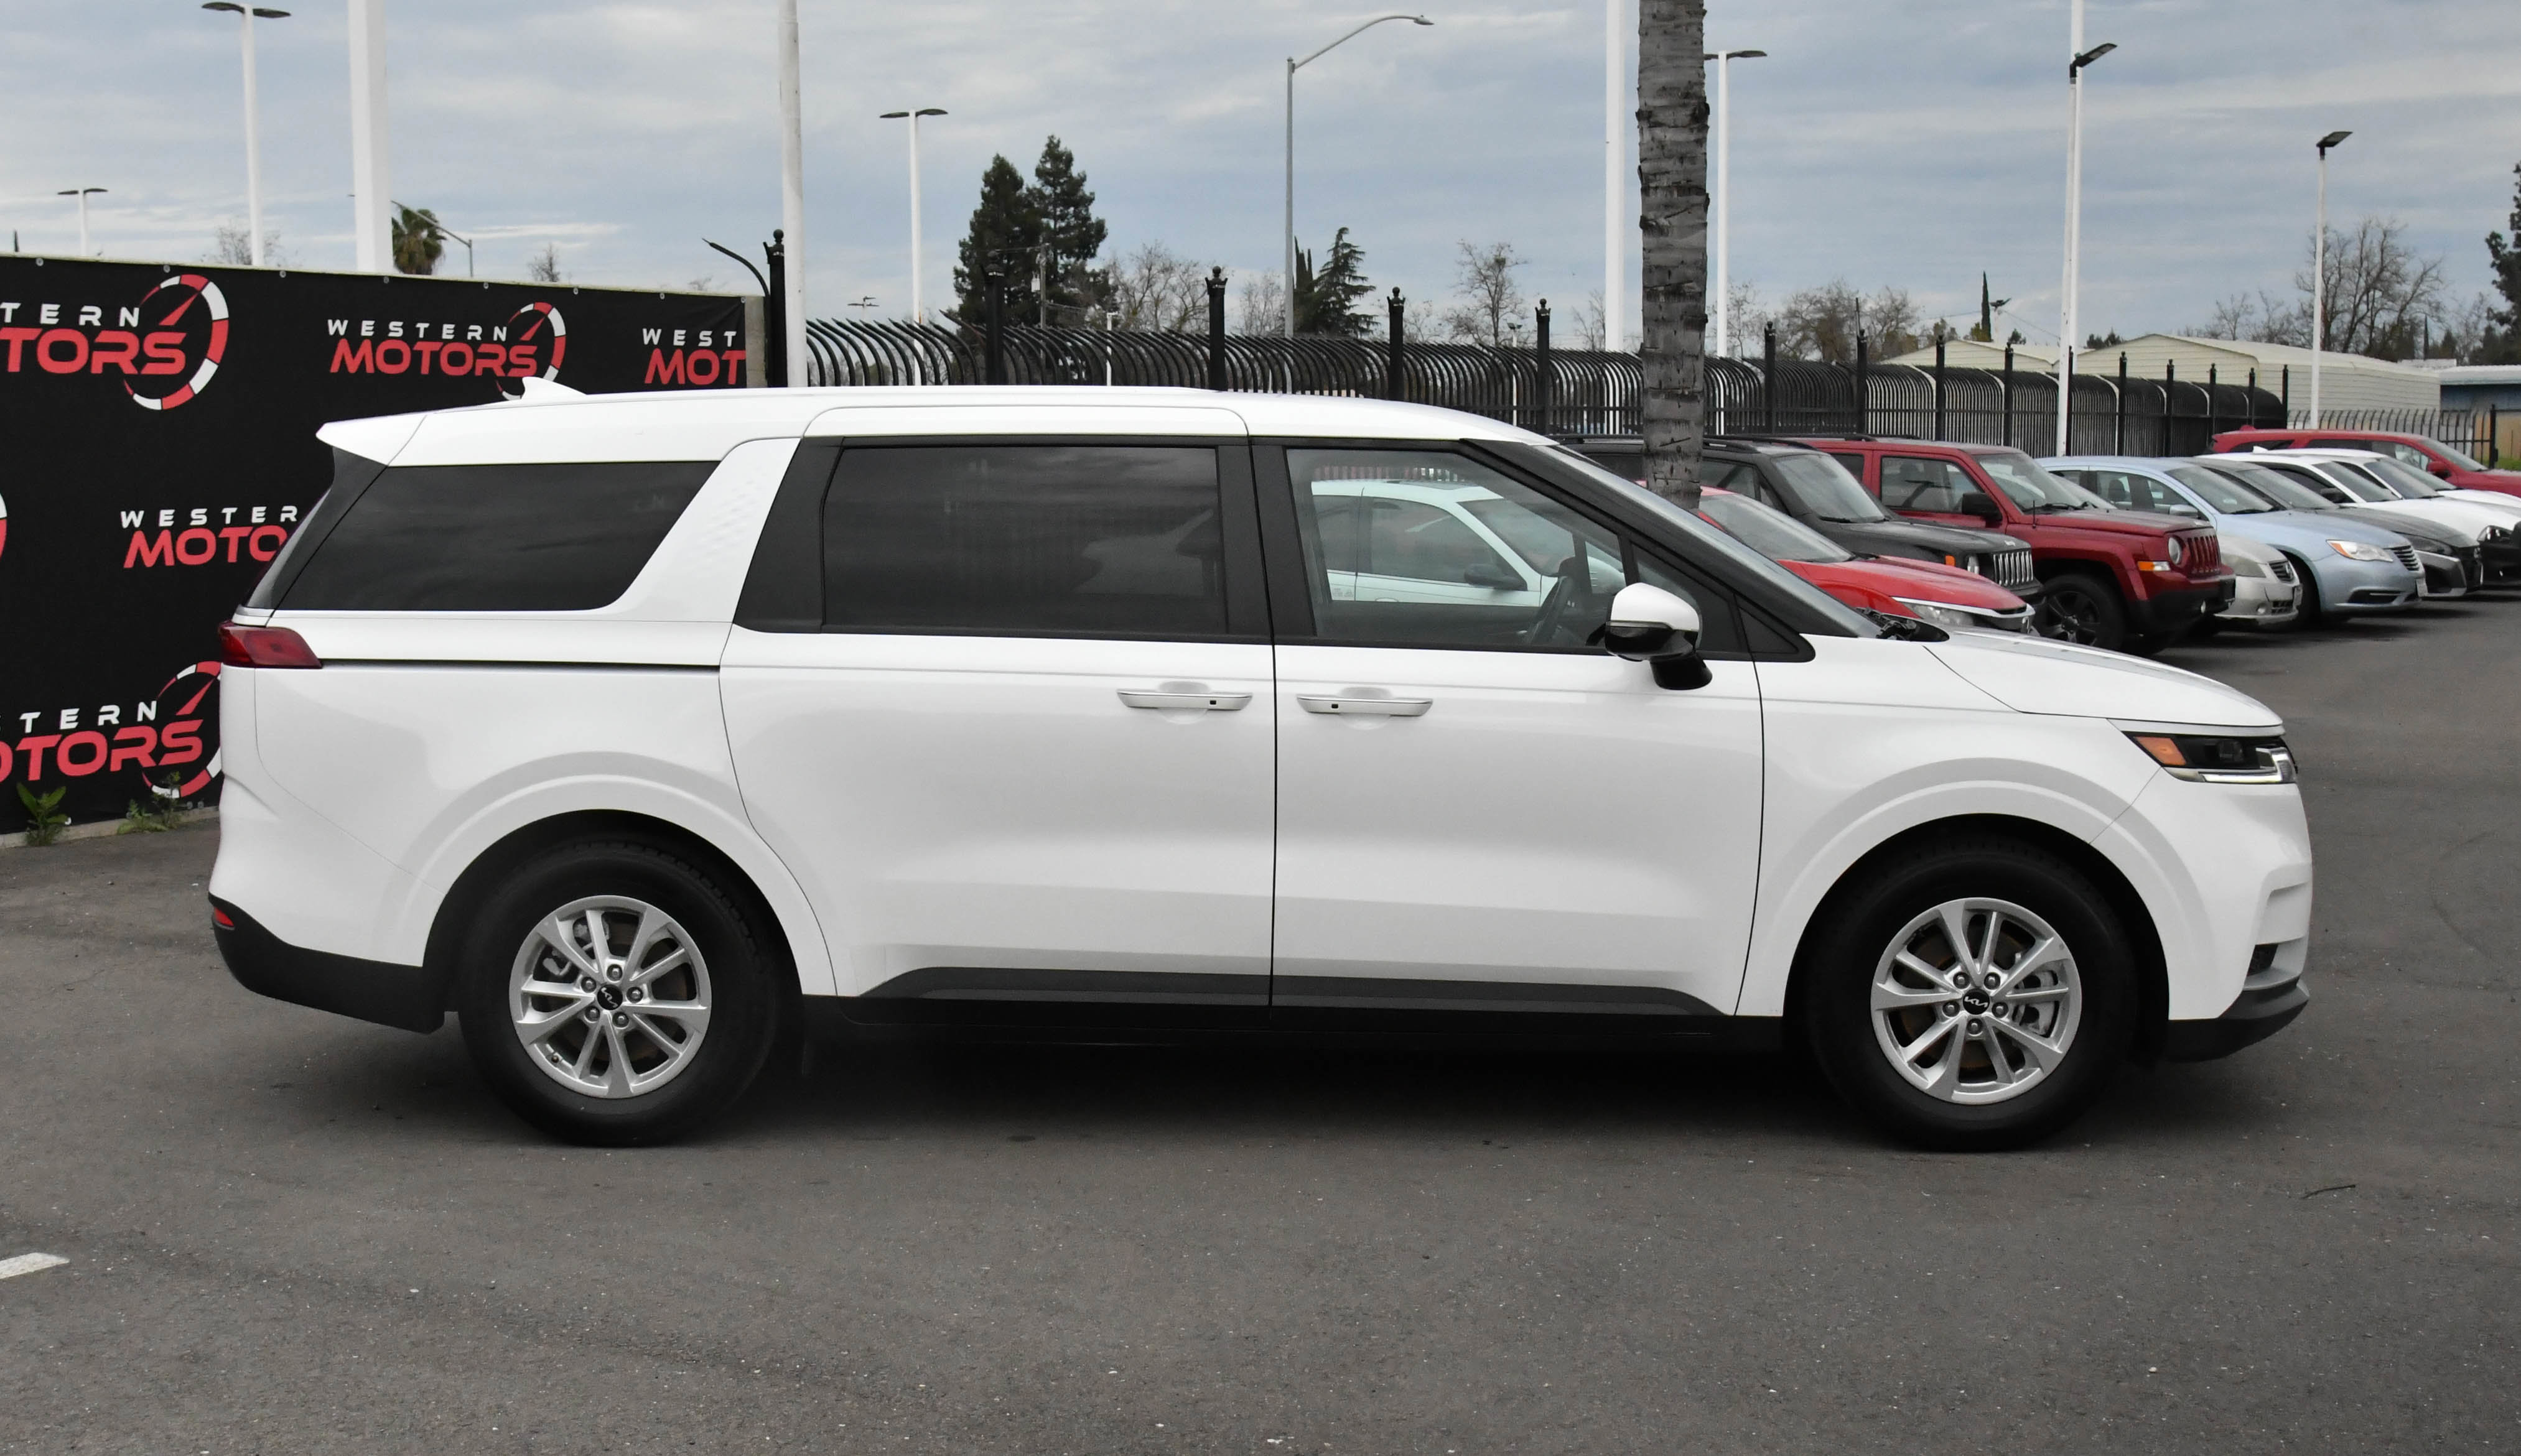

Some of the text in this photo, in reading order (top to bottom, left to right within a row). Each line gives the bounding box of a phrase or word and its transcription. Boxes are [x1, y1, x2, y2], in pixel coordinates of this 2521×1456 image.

[0, 302, 140, 327] TERN
[328, 320, 507, 341] WESTERN
[0, 327, 187, 374] TORS
[643, 328, 737, 347] WEST
[330, 338, 538, 378] MOTORS
[645, 348, 746, 386] MOT
[121, 506, 298, 529] WESTER
[123, 525, 288, 568] MOTO
[0, 700, 157, 733] TERN
[0, 719, 203, 782] TORS
